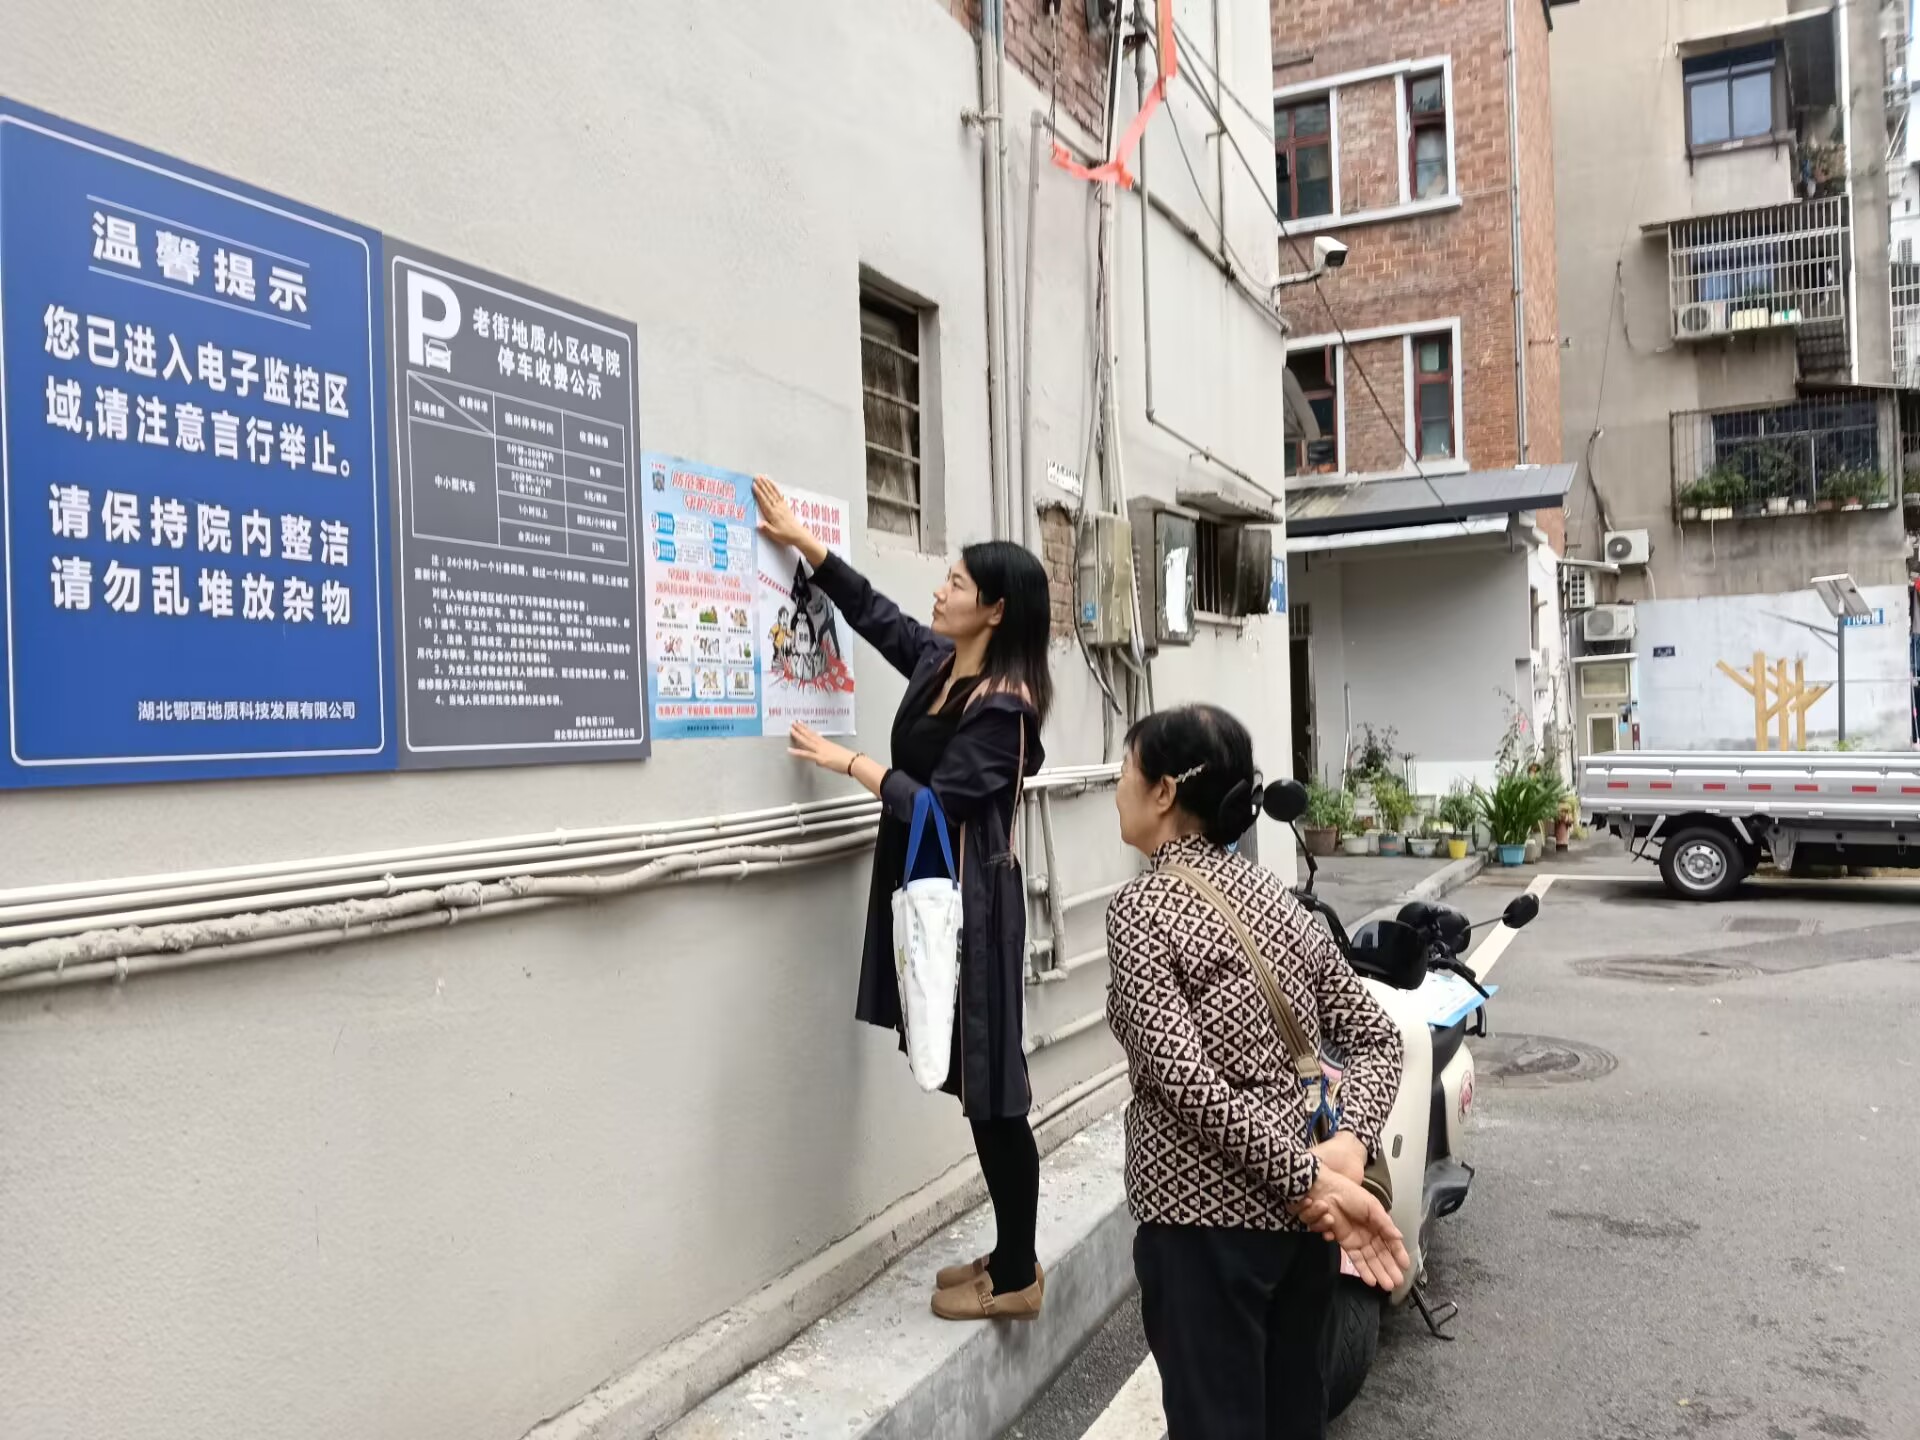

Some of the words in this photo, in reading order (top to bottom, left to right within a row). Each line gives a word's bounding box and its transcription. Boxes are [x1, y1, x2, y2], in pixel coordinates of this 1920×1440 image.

[92, 211, 307, 313] 温馨提示
[44, 304, 349, 418] 您已进入电子监控区
[473, 306, 620, 377] 老街地质小区4号院
[498, 346, 602, 400] 停车收费公示
[49, 484, 349, 567] 请保持院内整洁
[51, 556, 350, 625] 请勿乱堆放杂物
[138, 701, 355, 721] 湖北鄂西地质科技发展有限公司
